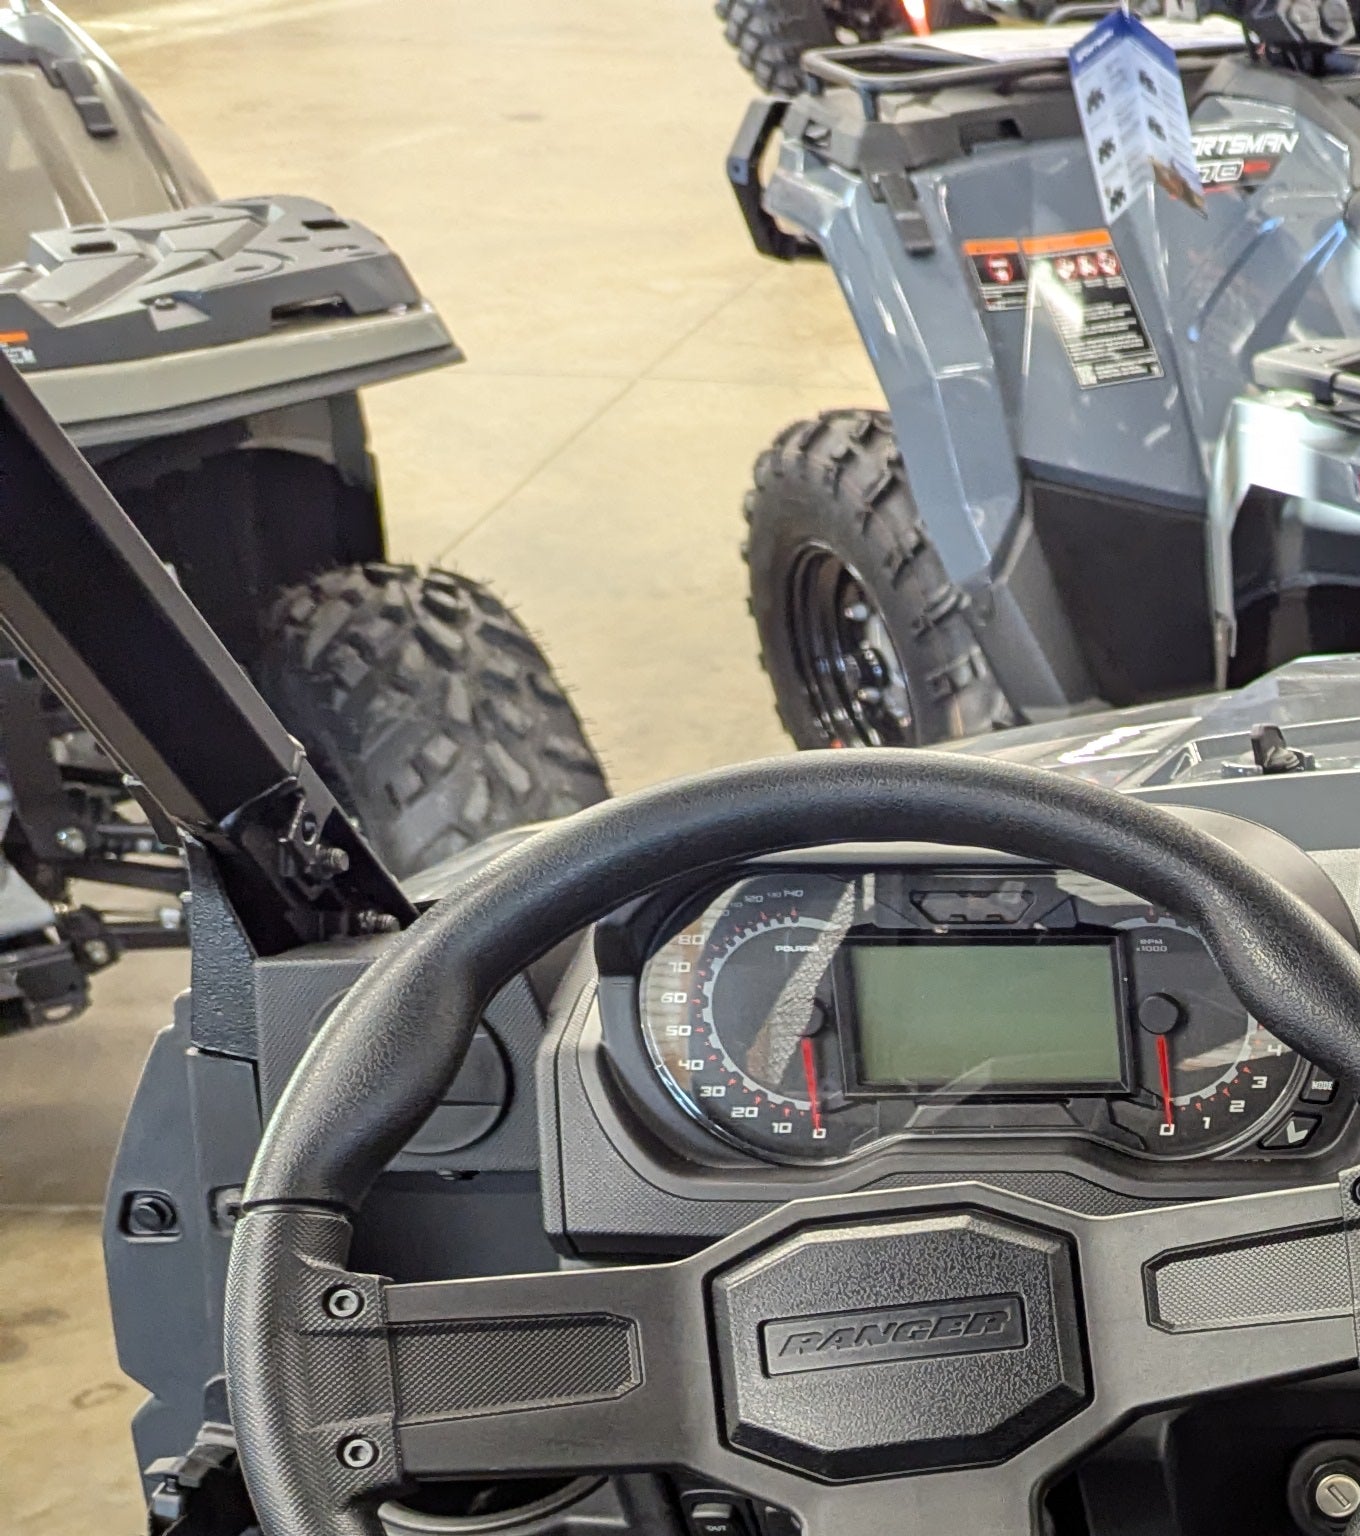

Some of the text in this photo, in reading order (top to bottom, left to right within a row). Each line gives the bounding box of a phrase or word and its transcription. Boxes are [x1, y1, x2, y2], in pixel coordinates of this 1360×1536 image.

[678, 934, 705, 945] 80
[669, 962, 691, 973] 70
[661, 992, 687, 1004] 60
[665, 1025, 692, 1036] 50
[1267, 1044, 1283, 1057] 4
[678, 1059, 704, 1071] 40
[1251, 1076, 1268, 1089] 3
[1311, 1080, 1333, 1091] MODE
[700, 1086, 726, 1097] 30
[731, 1106, 759, 1118] 20
[1229, 1100, 1246, 1113] 2
[771, 1122, 793, 1134] 10
[1202, 1117, 1211, 1129] 1
[812, 1128, 827, 1139] 0
[1159, 1124, 1175, 1136] 0
[778, 1310, 1012, 1357] RANGER
